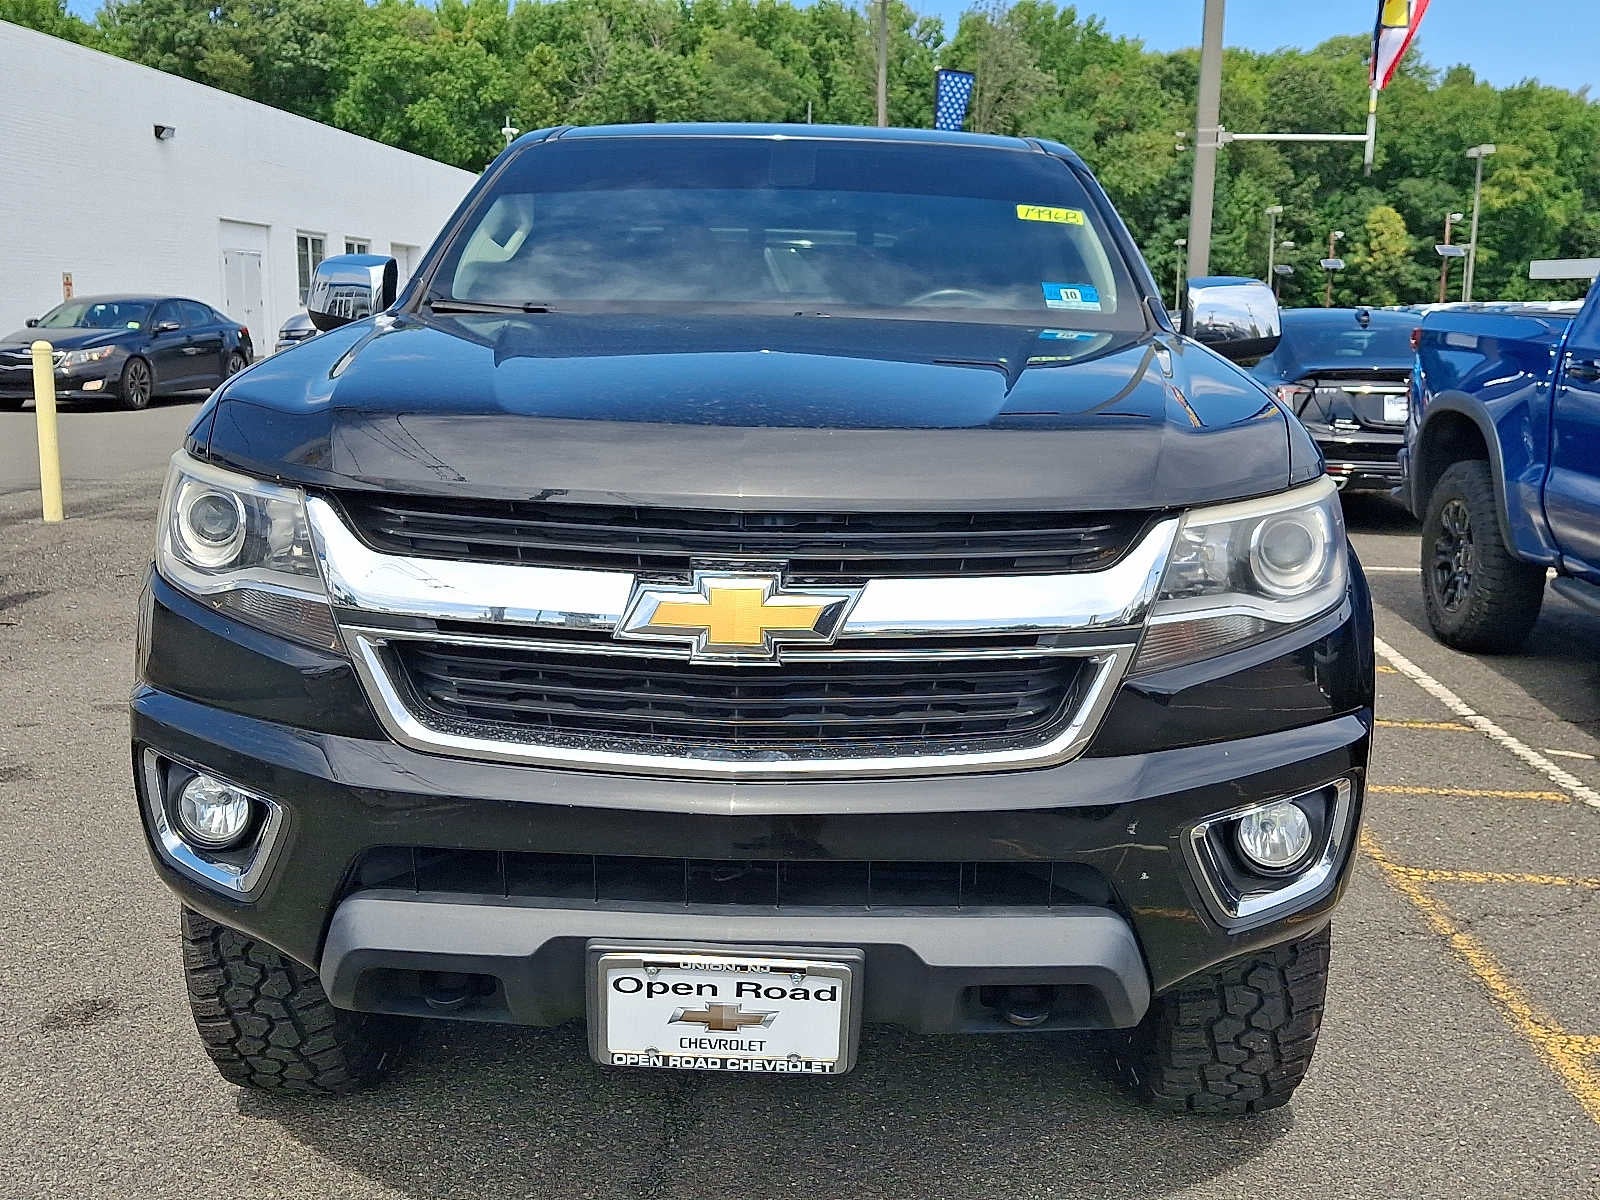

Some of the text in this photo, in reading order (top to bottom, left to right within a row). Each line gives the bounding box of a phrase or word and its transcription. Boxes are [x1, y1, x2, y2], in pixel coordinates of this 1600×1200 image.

[1064, 291, 1078, 300] 10
[748, 964, 770, 974] NJ
[613, 976, 837, 1002] Open Road
[679, 1037, 767, 1052] CHEVROLET
[613, 1053, 834, 1073] OPEN ROAD CHEVROLET
